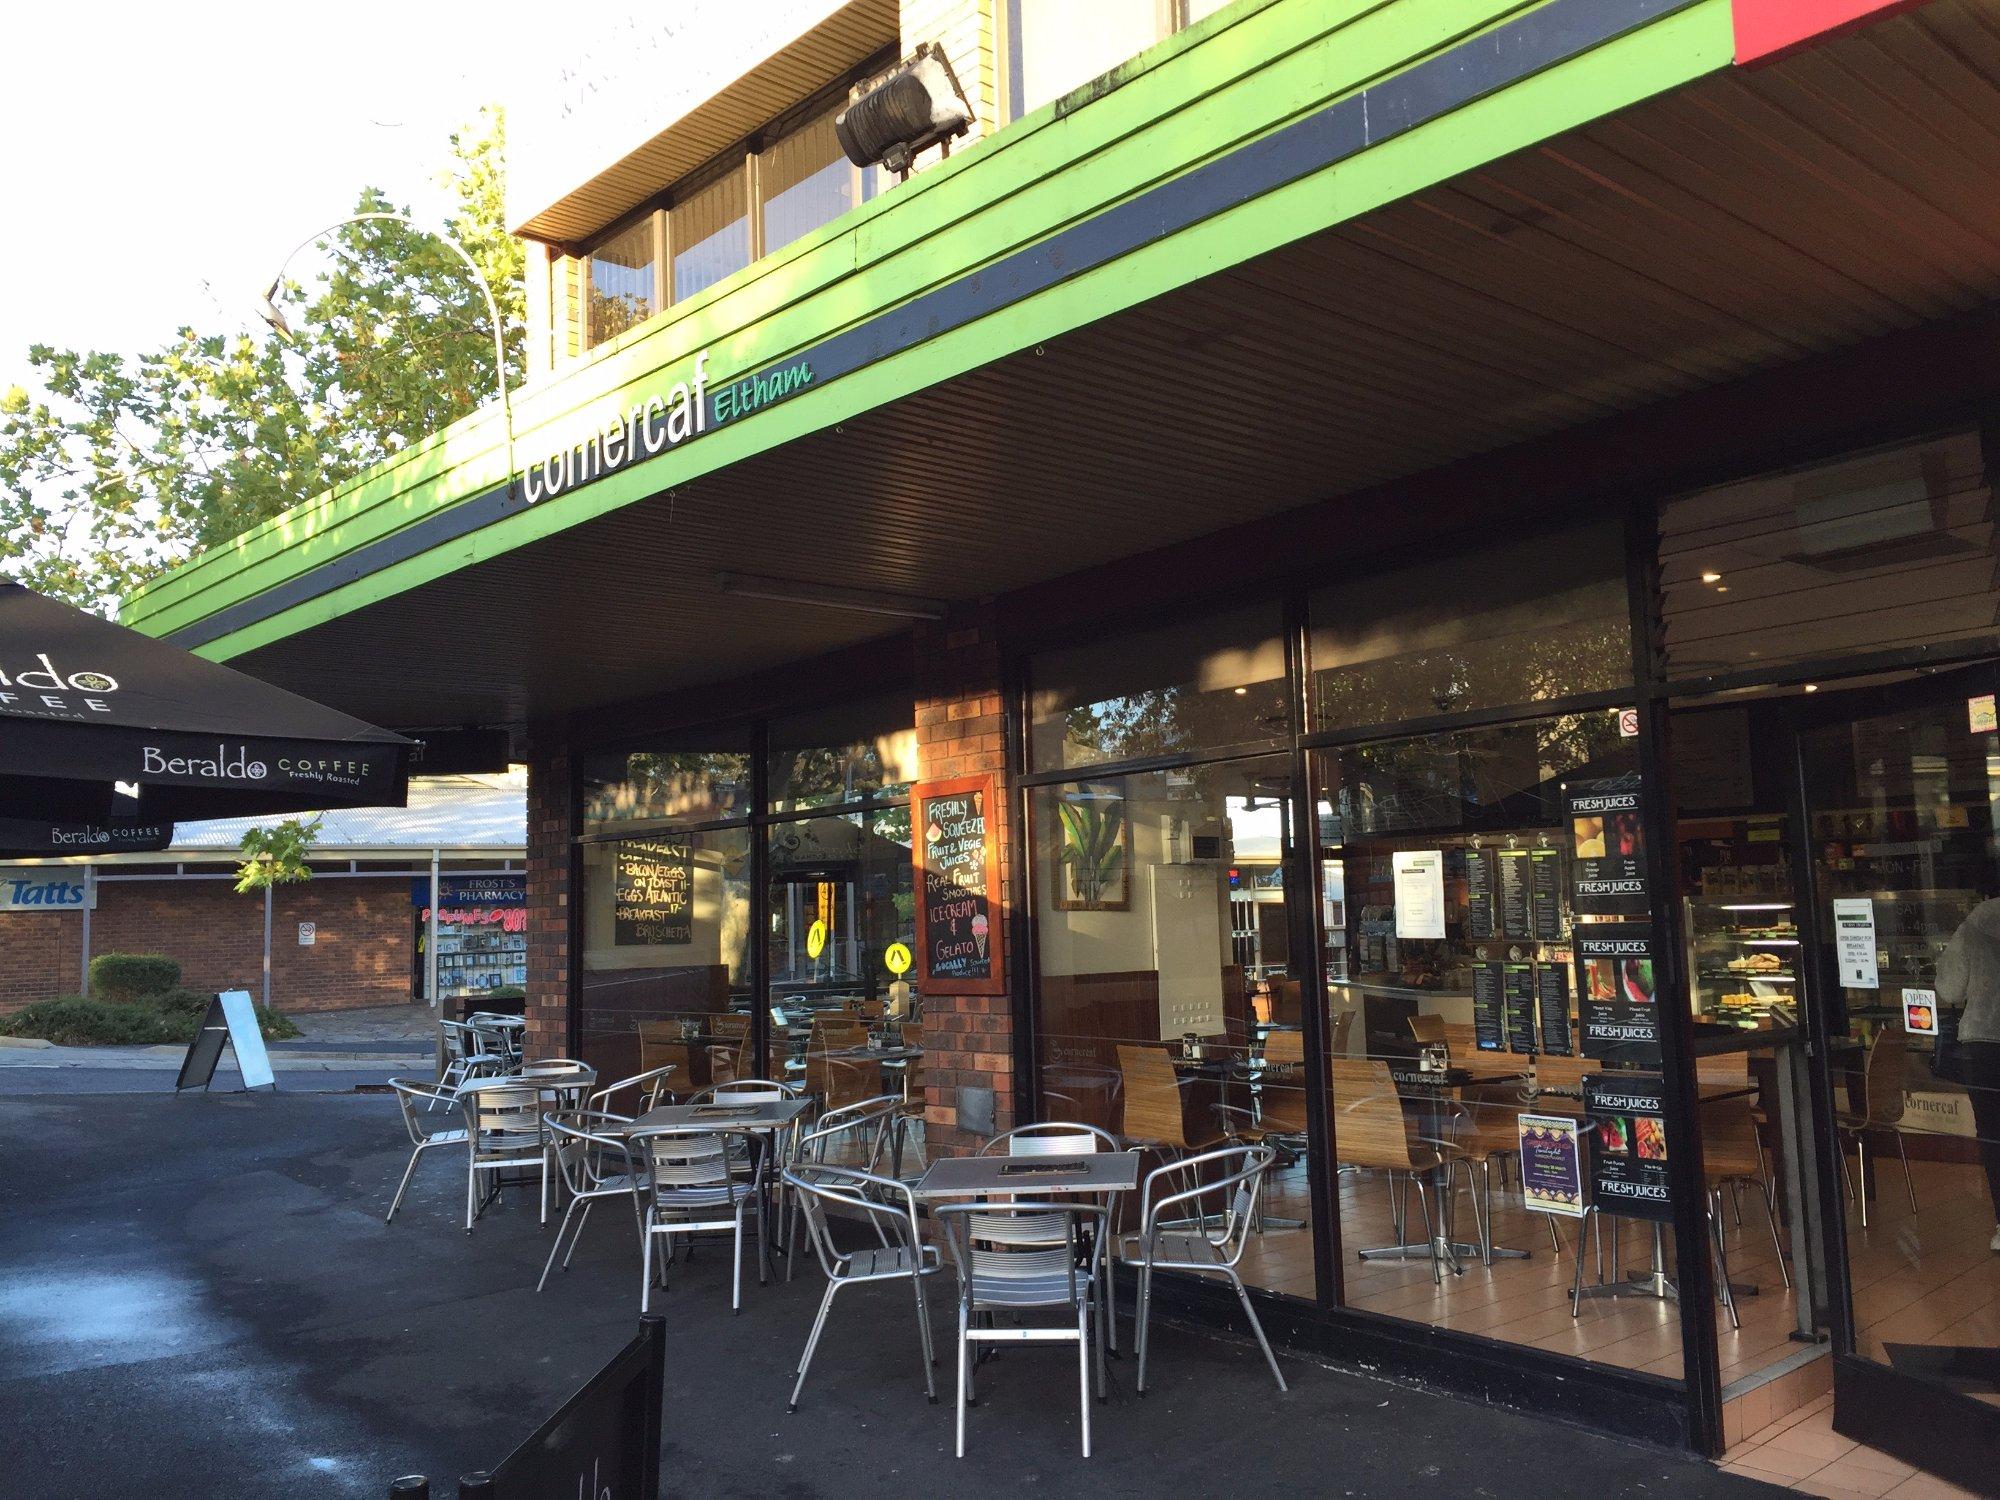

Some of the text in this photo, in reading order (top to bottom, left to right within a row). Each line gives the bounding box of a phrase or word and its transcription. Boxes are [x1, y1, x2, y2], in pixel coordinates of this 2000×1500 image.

[714, 361, 815, 422] Eltham
[142, 744, 370, 779] Beraldo COFFEE
[289, 771, 360, 786] Freshly Roasted
[1573, 796, 1636, 811] FRESH JUICES
[929, 800, 968, 824] FRESHLY
[52, 825, 110, 843] Beraldo
[112, 827, 160, 837] COFFEE
[950, 843, 957, 854] &
[958, 838, 982, 852] VEGIE
[940, 852, 971, 870] JUICES
[469, 879, 516, 889] FROST'S
[649, 878, 678, 892] TOAST
[952, 867, 980, 887] FRUIT
[9, 880, 84, 905] Tatts
[1579, 881, 1642, 894] FRESH JUICES
[459, 891, 525, 901] PHARMACY
[936, 940, 974, 960] GELATO
[1583, 942, 1614, 952] FRESH
[1614, 942, 1646, 954] JUICES
[1905, 992, 1933, 1005] OPEN
[1589, 1026, 1653, 1040] FRESH JUICES
[1595, 1096, 1659, 1110] FRESH JUICES
[1905, 1097, 1959, 1115] cornercaf
[1601, 1181, 1667, 1198] FRESH JUICES
